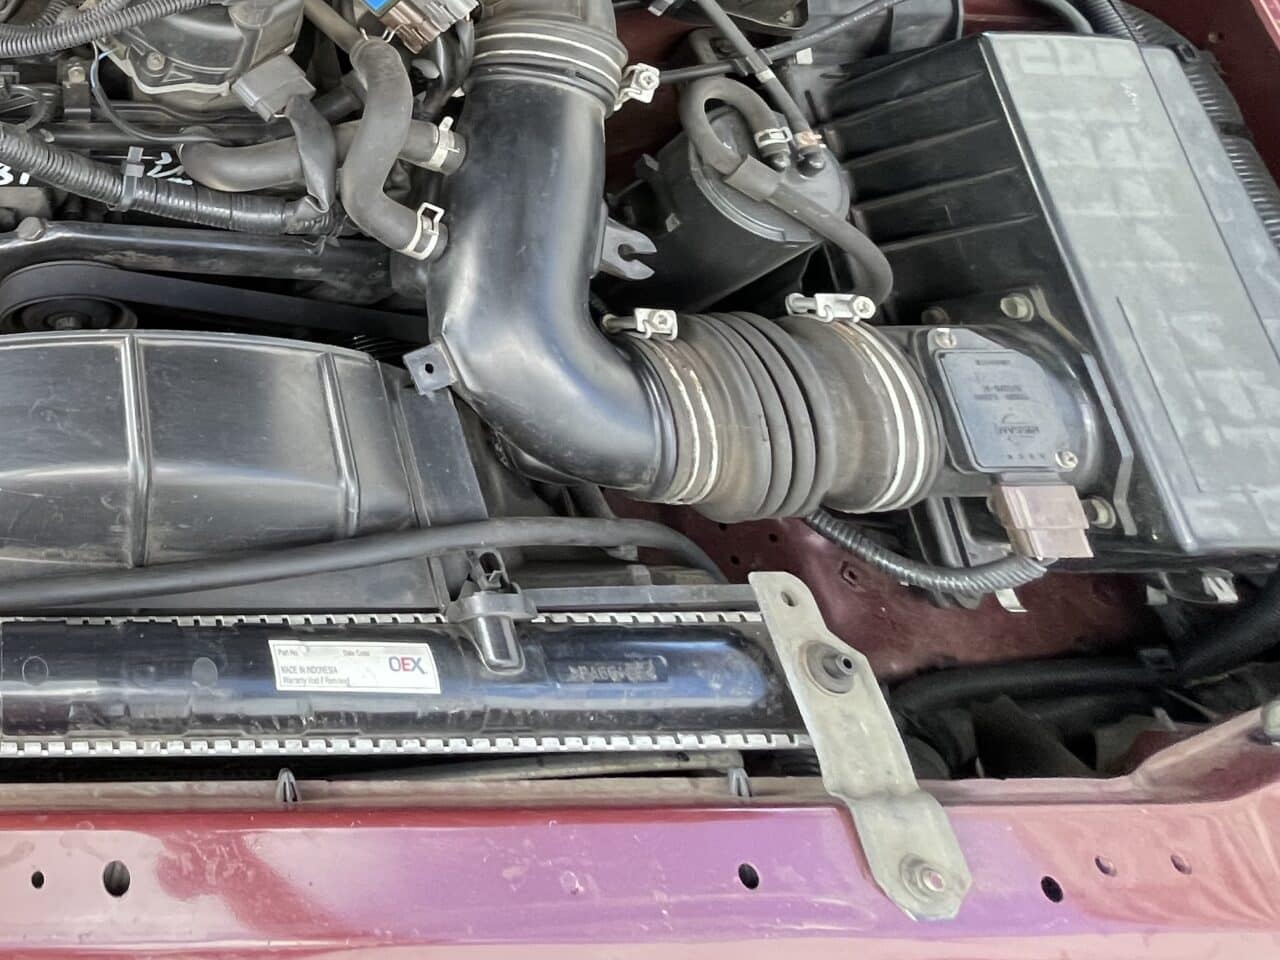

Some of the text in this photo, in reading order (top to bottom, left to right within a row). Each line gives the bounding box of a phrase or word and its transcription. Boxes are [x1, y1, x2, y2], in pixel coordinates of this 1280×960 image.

[280, 665, 298, 674] MADE
[306, 666, 338, 675] INDONESIA
[388, 655, 426, 675] OEX
